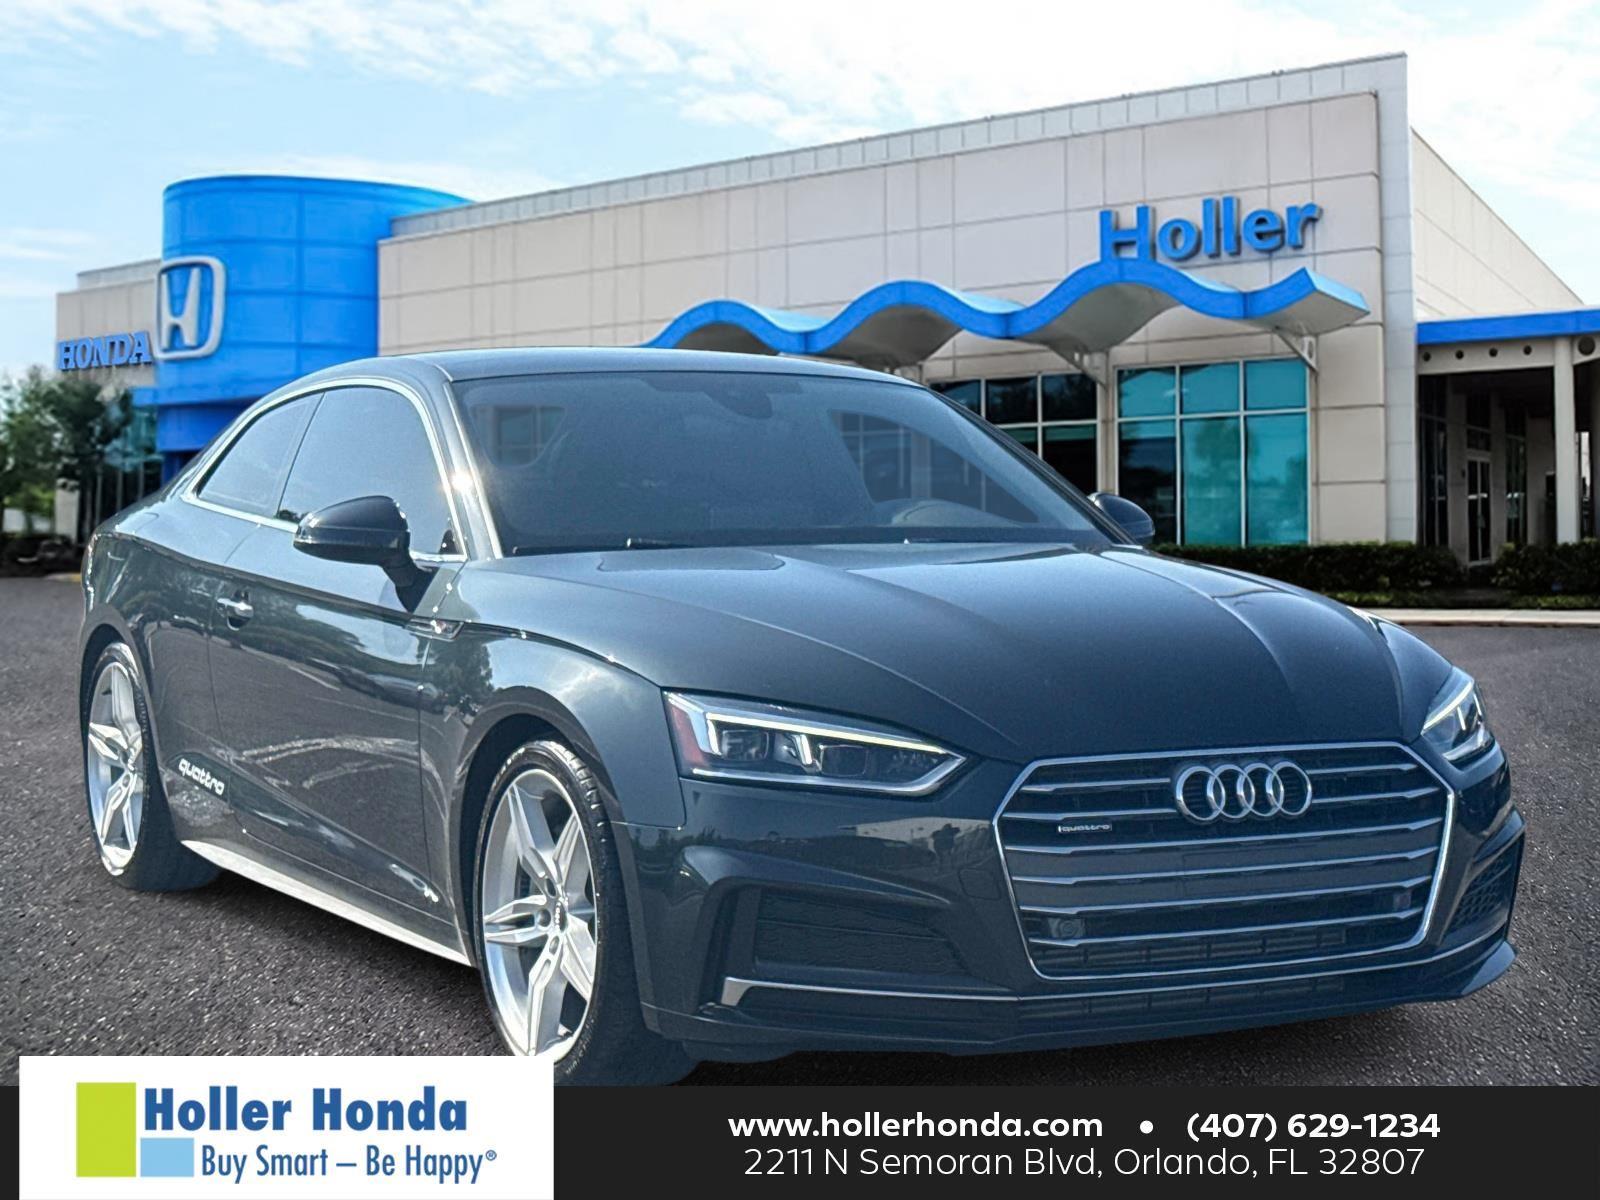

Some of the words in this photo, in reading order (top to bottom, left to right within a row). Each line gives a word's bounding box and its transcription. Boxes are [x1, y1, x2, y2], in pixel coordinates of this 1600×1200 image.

[1100, 196, 1322, 261] Holler
[57, 331, 153, 370] HONDA
[179, 758, 225, 795] quattro
[1062, 824, 1110, 833] quattro
